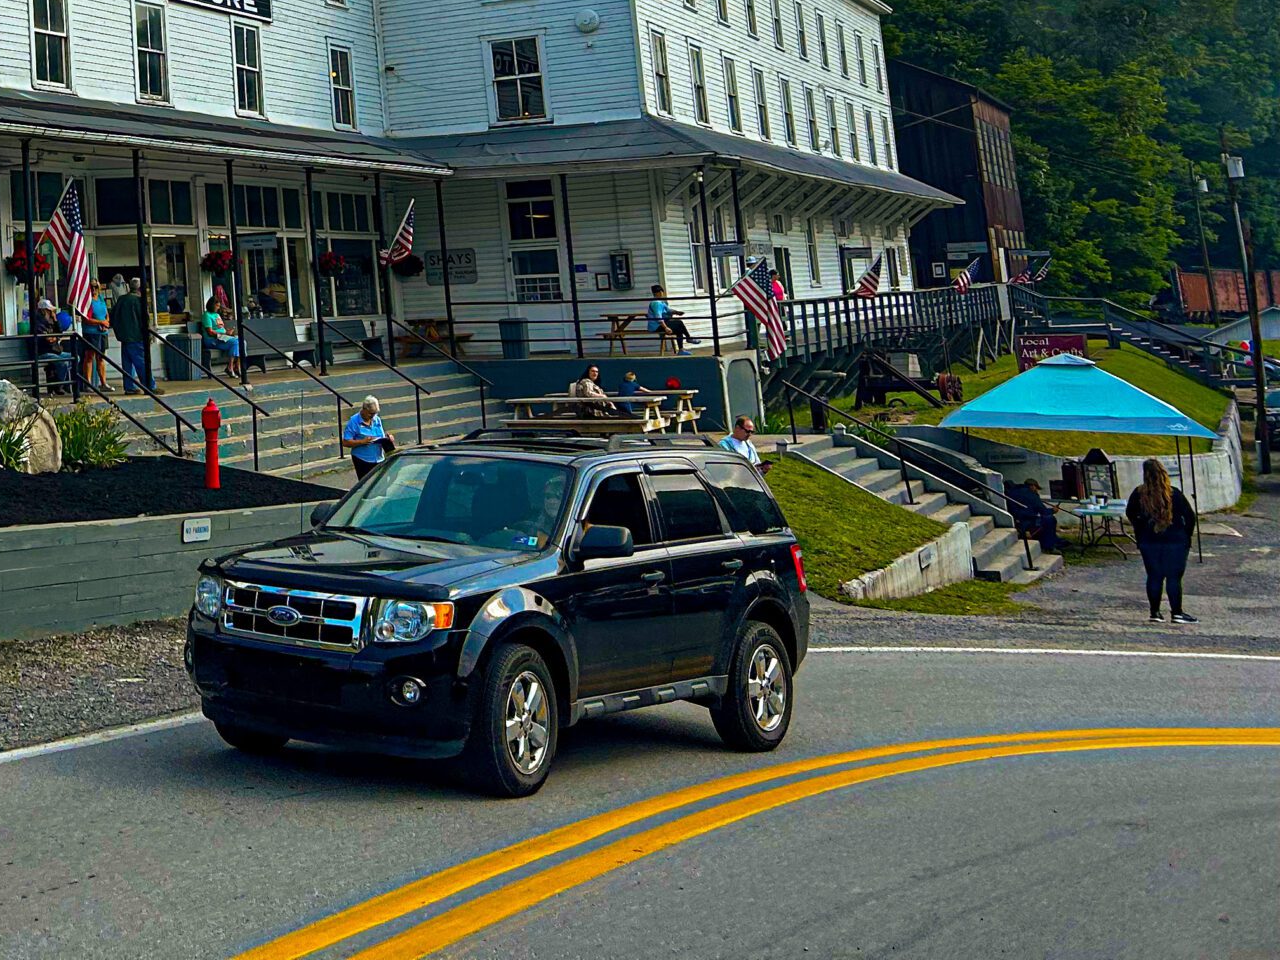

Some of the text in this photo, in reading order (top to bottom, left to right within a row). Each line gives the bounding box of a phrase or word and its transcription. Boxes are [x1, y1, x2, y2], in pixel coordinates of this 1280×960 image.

[1020, 337, 1050, 346] Local
[1022, 348, 1038, 358] Art
[1041, 348, 1050, 358] &
[185, 527, 192, 535] NO
